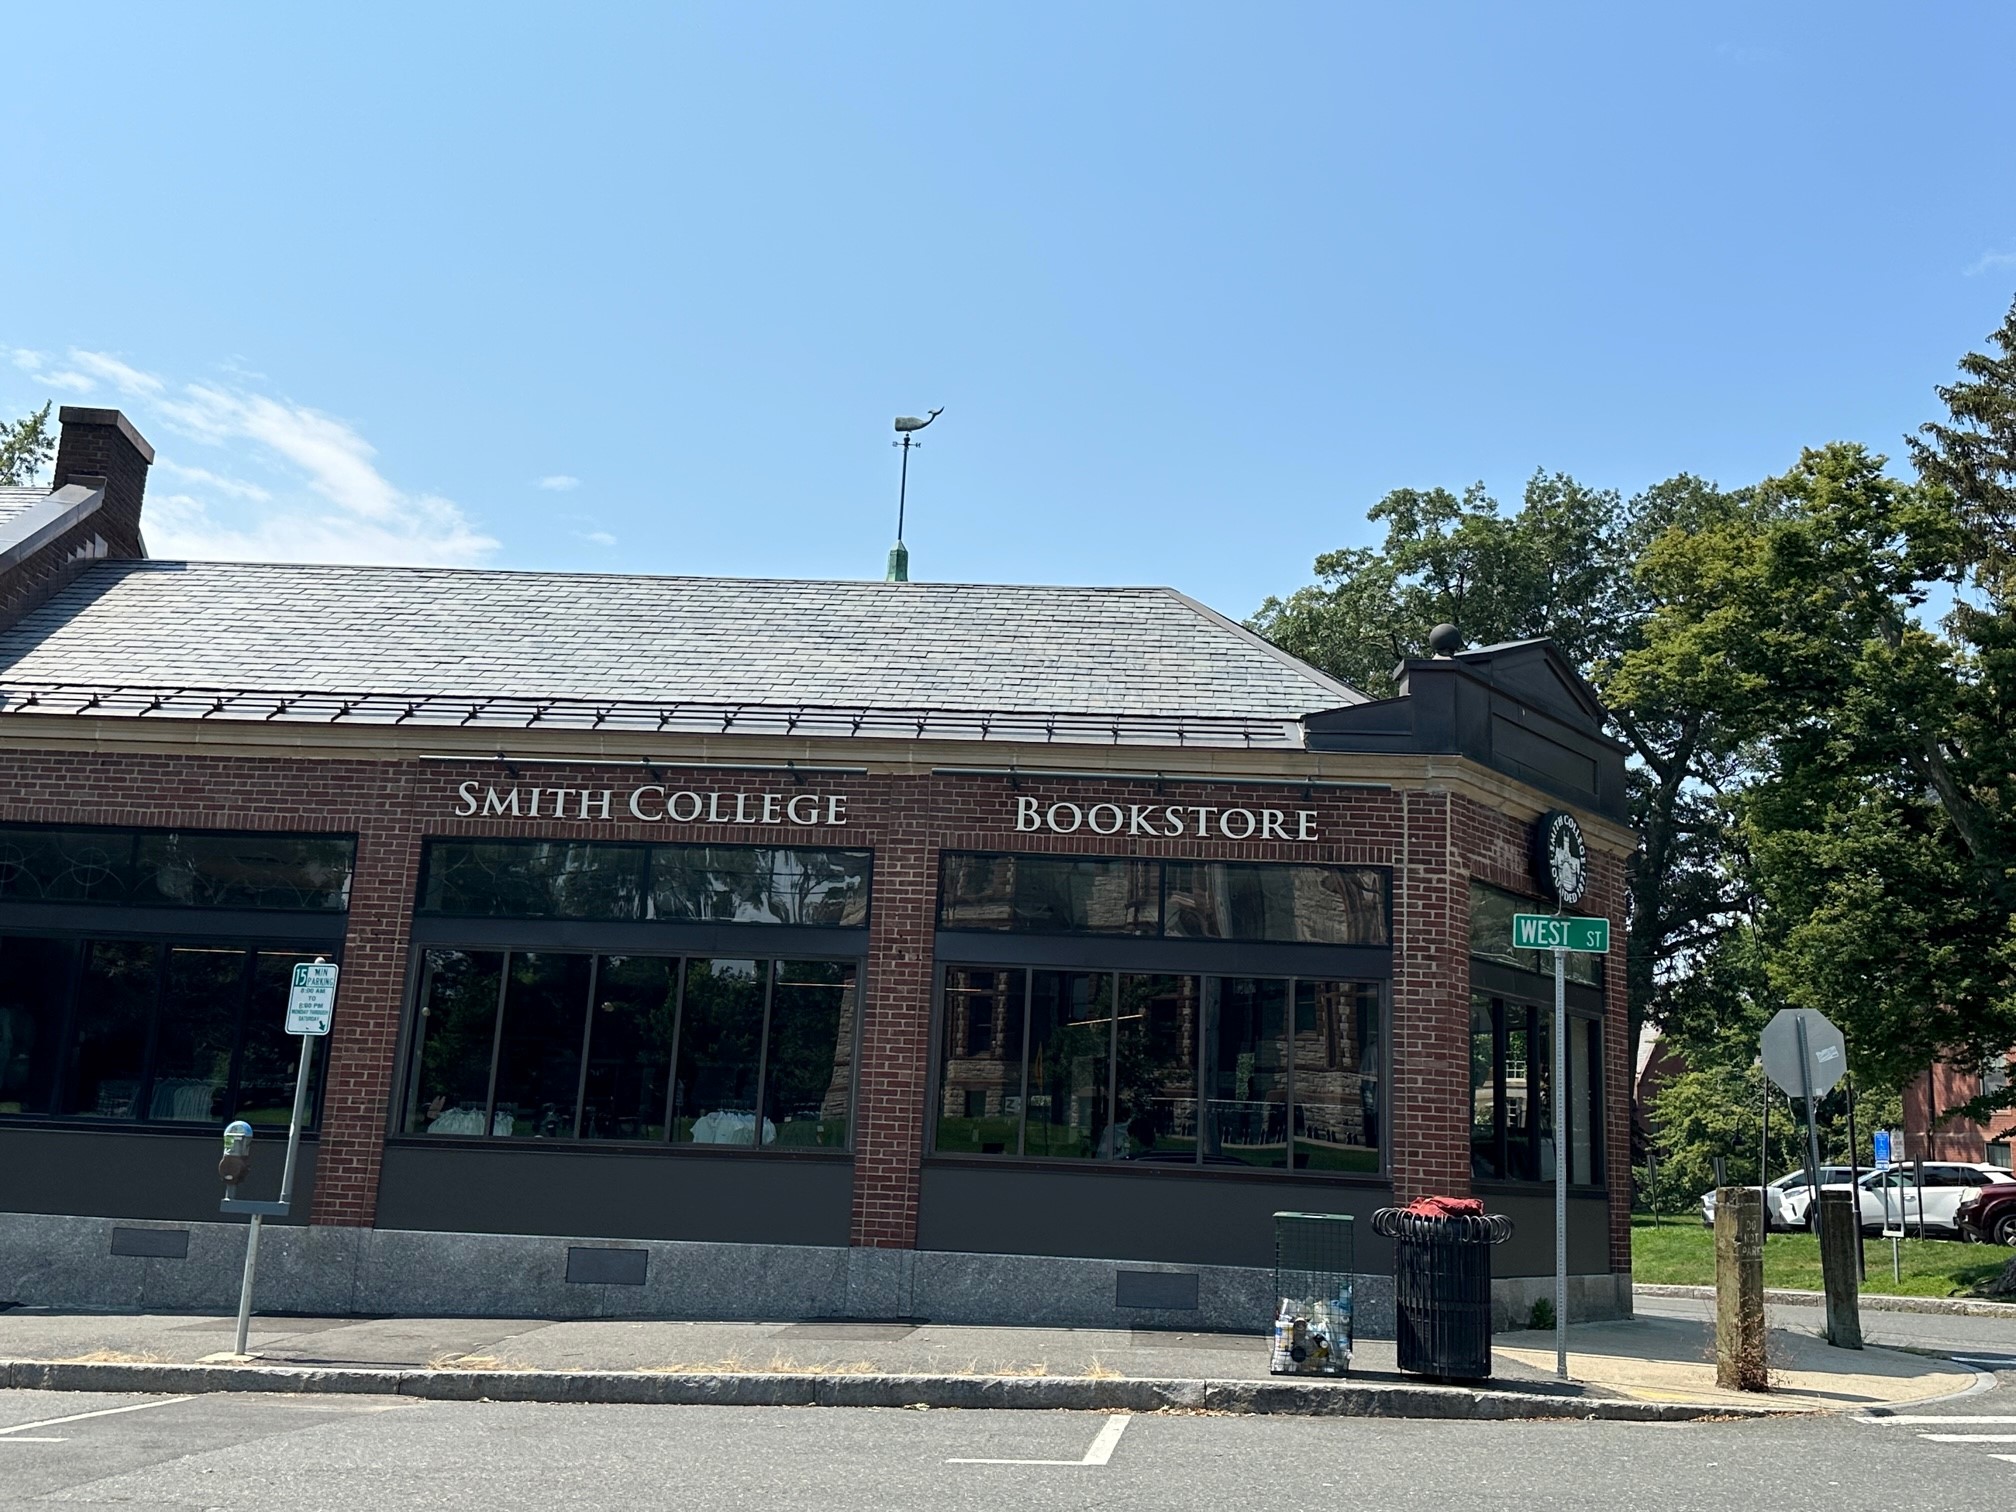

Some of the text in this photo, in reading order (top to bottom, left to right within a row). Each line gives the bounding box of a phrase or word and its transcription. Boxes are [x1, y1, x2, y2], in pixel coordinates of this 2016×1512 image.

[455, 781, 848, 825] SMITH COLLEGE
[1014, 796, 1319, 841] BOOKSTORE
[1549, 815, 1587, 864] SMITH COLLEGE
[1521, 919, 1602, 948] WEST ST
[295, 968, 329, 986] 15 MIN
[307, 977, 334, 986] PARKING
[1746, 1220, 1757, 1231] DO
[1744, 1232, 1760, 1244] NOT
